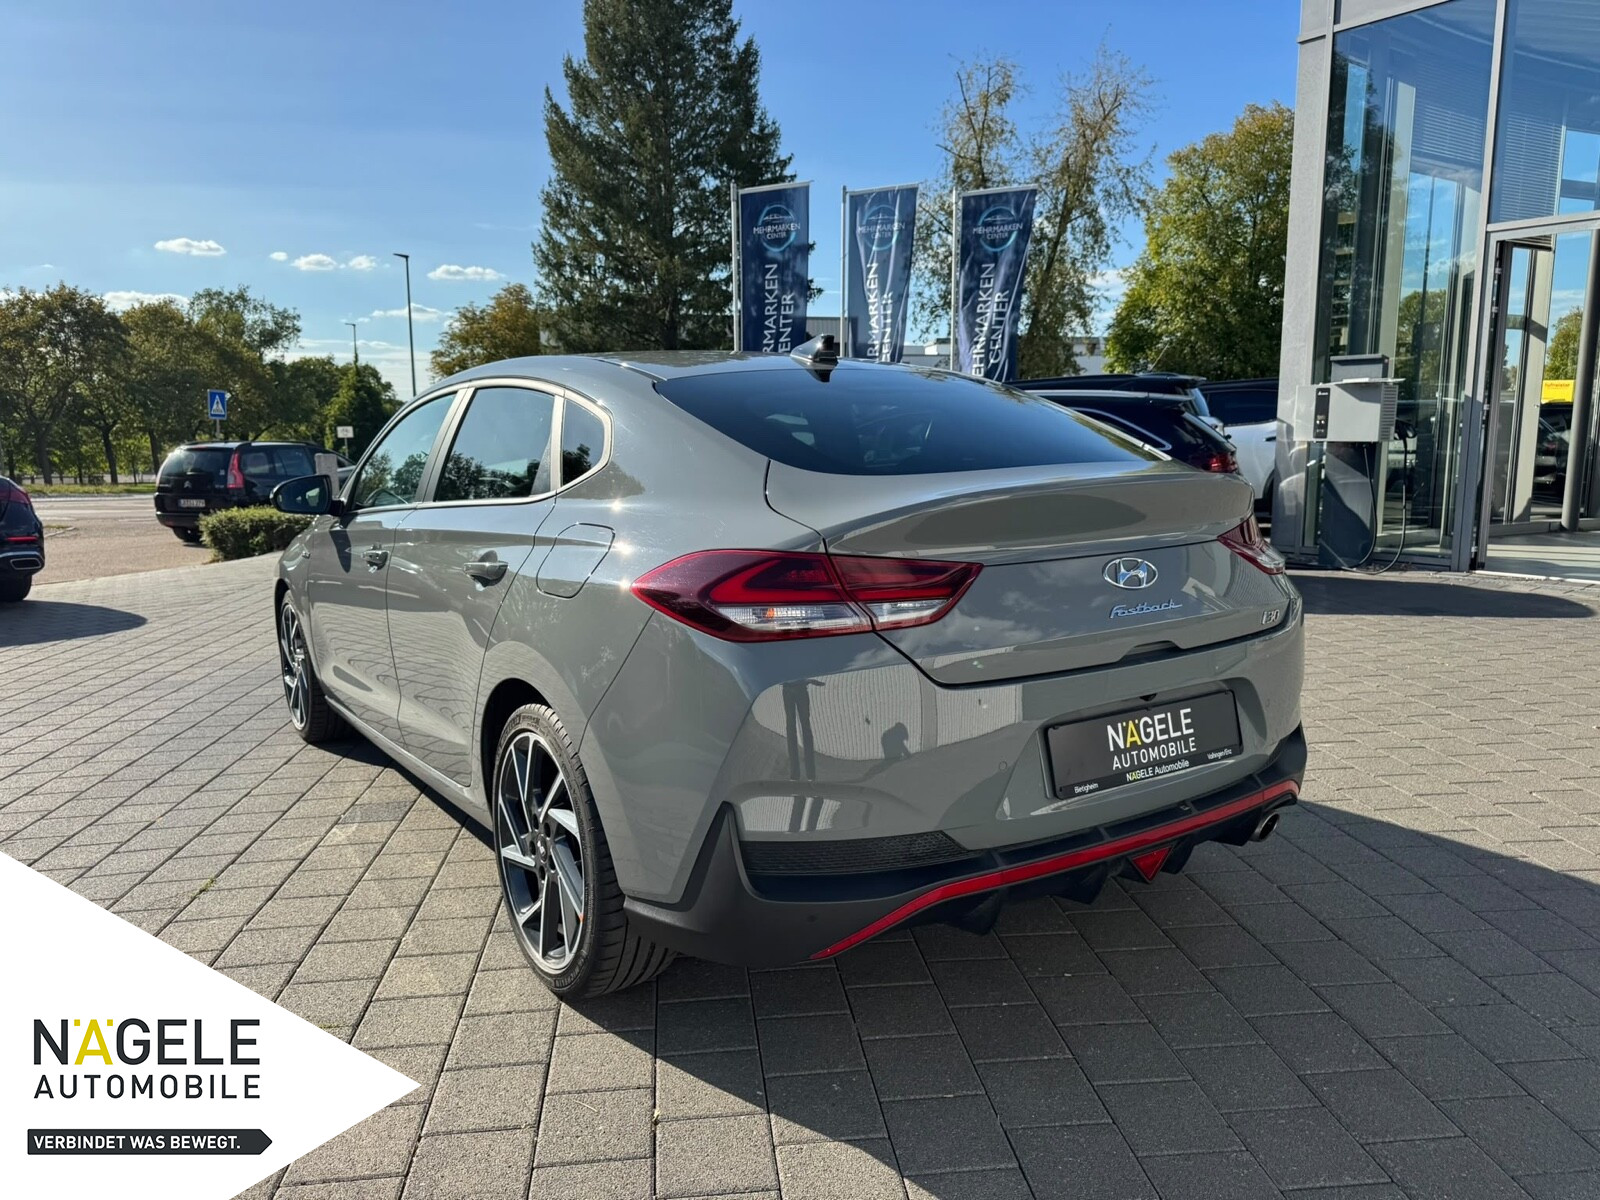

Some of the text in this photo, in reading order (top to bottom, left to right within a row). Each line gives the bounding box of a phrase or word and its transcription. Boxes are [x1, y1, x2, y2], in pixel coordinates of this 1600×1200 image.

[753, 223, 801, 235] MEHRMARKEN
[972, 222, 1023, 235] MEHRMARKEN
[988, 290, 1009, 363] CENTER
[1110, 598, 1182, 619] Fastback
[1261, 610, 1281, 625] i30
[1107, 708, 1194, 751] NÄGELE
[1112, 737, 1197, 770] AUTOMOBILE
[1154, 759, 1190, 775] Automobile
